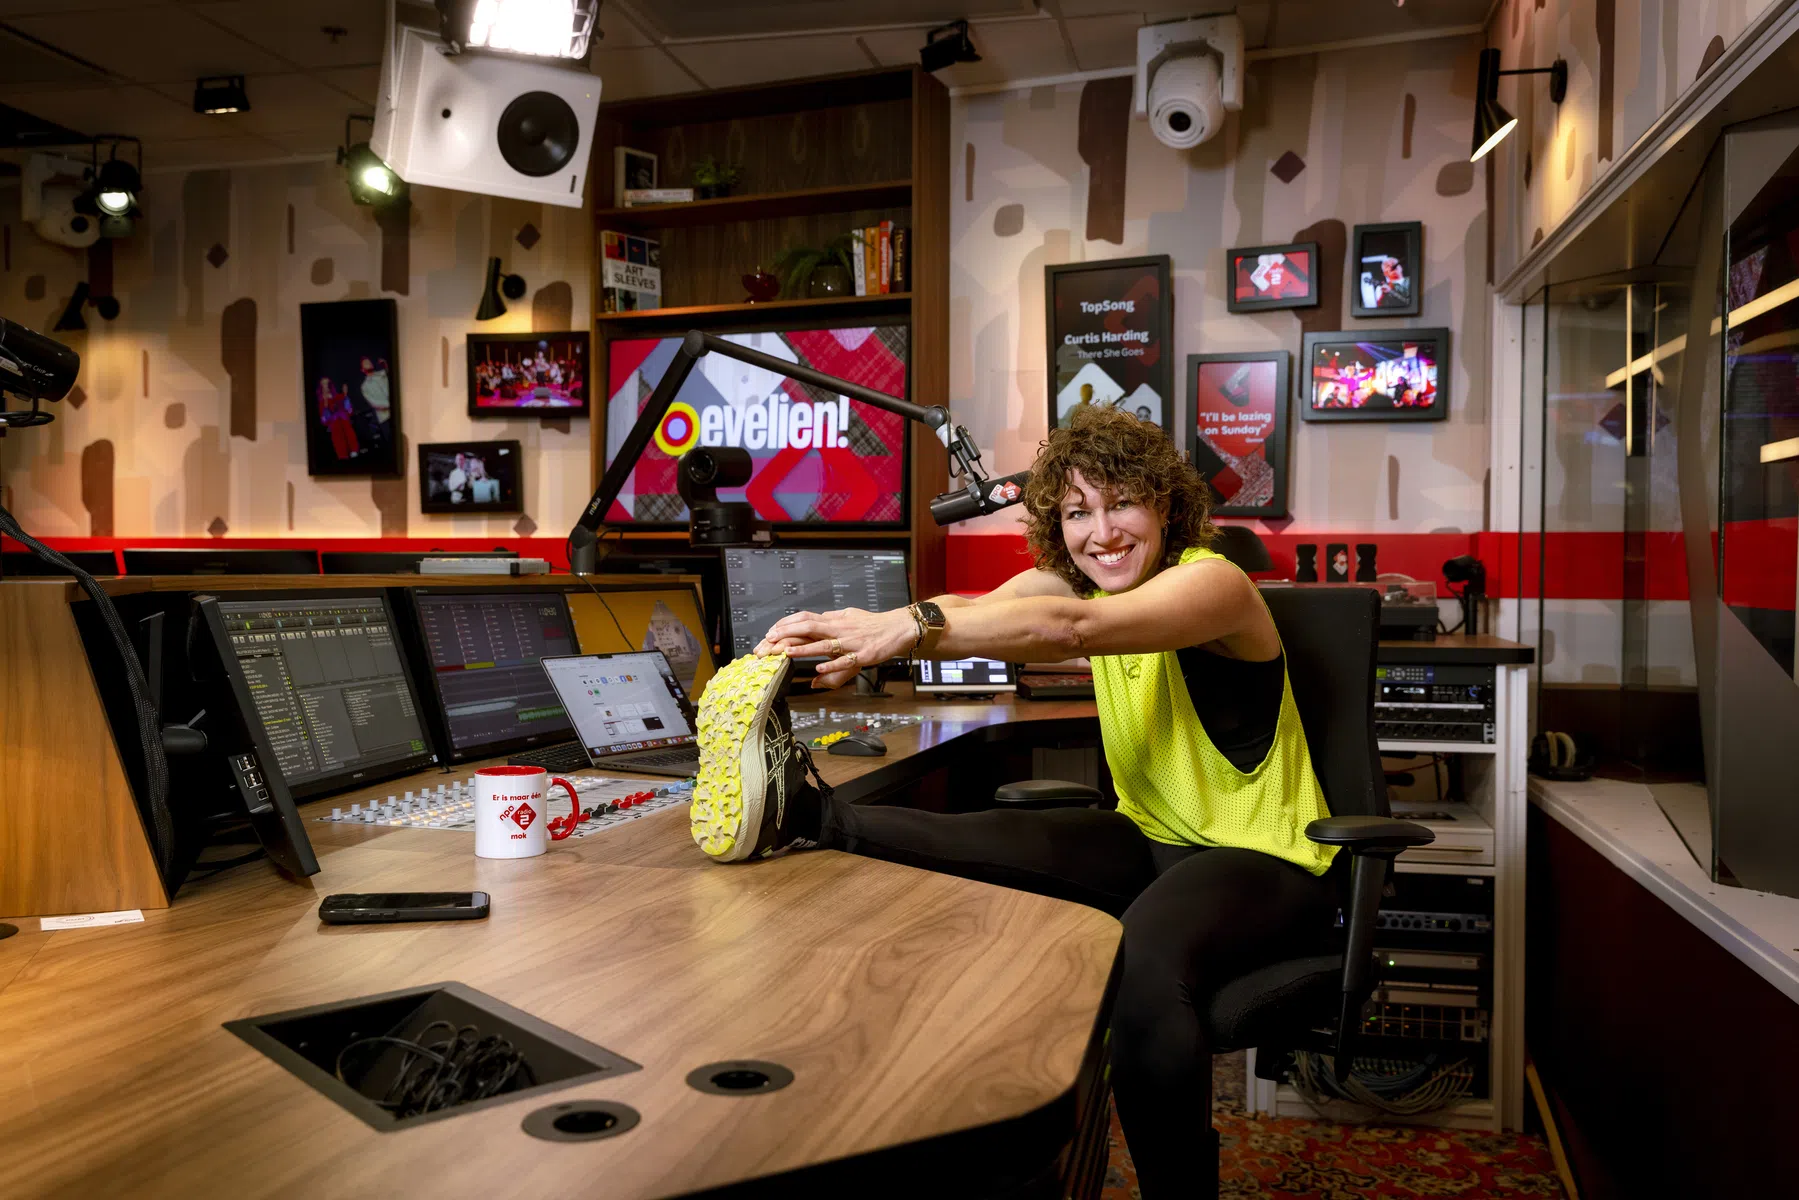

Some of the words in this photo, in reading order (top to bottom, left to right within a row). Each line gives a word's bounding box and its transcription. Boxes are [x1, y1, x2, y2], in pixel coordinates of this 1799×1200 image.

[625, 265, 644, 276] ART
[614, 272, 656, 290] SLEEVES
[1080, 300, 1135, 315] TopSong
[1064, 332, 1100, 345] Curtis
[1102, 330, 1149, 343] Harding
[1077, 350, 1102, 359] There
[1104, 348, 1121, 358] She
[1121, 348, 1144, 356] Goes
[700, 393, 850, 450] evelien!
[1222, 412, 1236, 422] be
[1238, 411, 1271, 423] lazing
[1205, 427, 1218, 435] on
[1221, 424, 1267, 436] Sunday"
[990, 485, 1001, 500] npo
[499, 805, 515, 821] npo
[520, 814, 529, 825] 2
